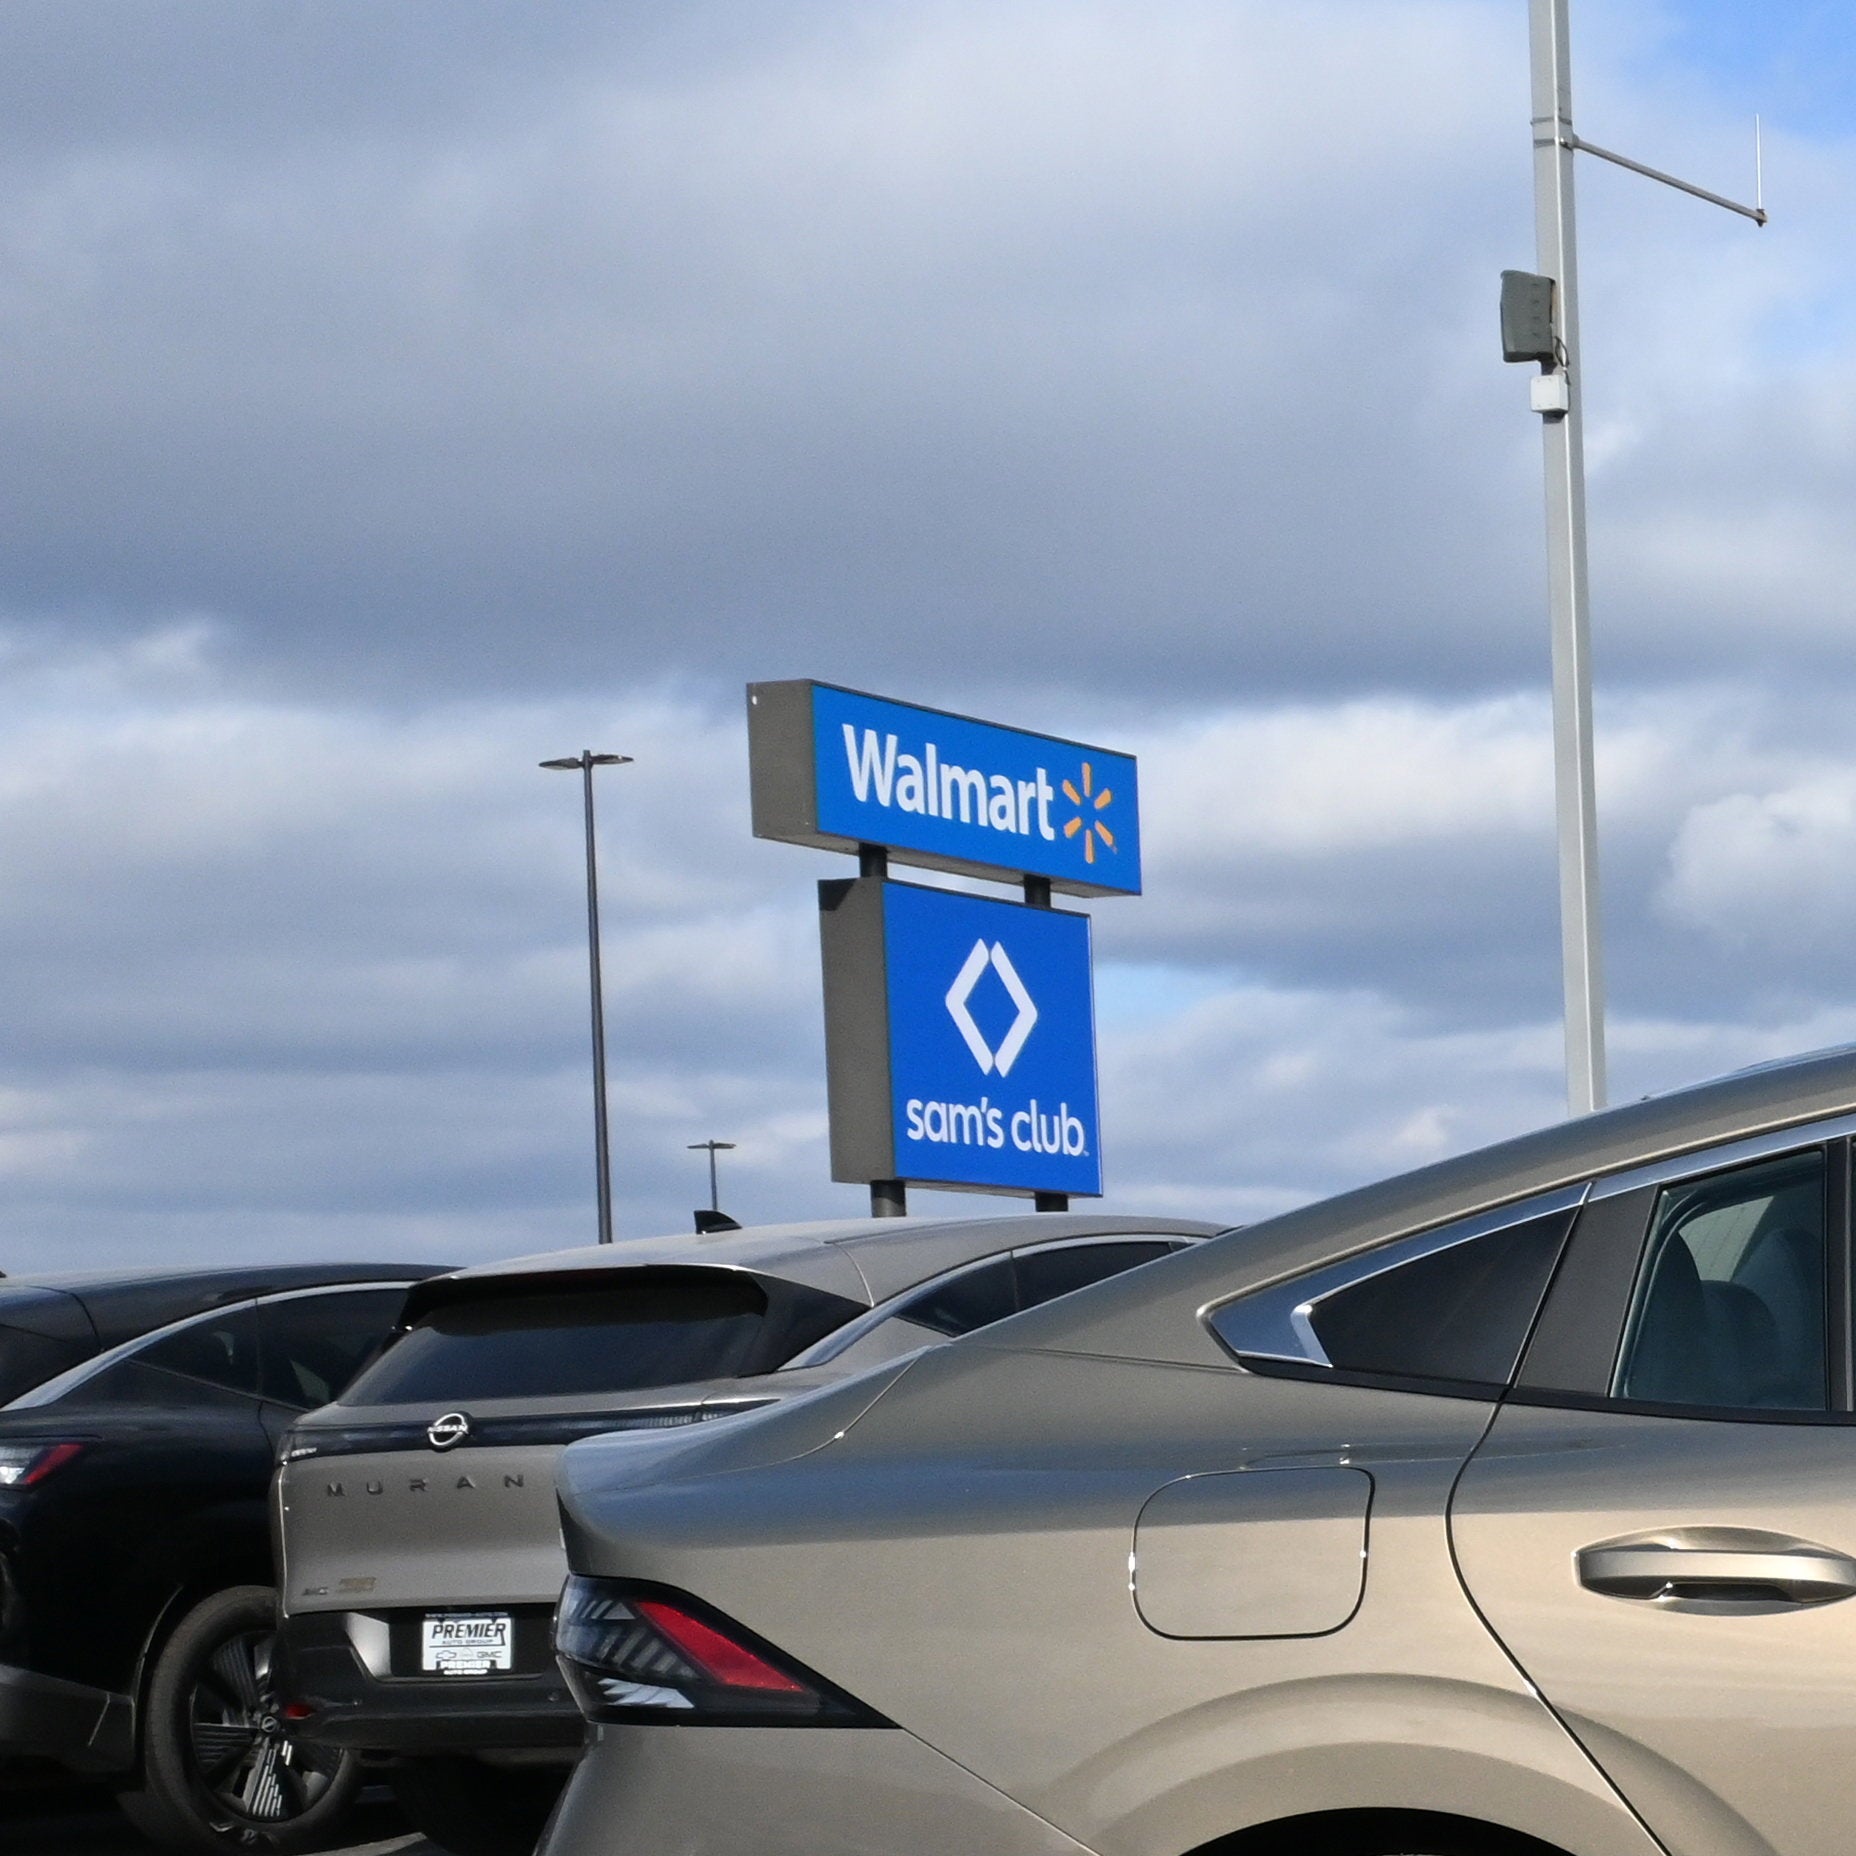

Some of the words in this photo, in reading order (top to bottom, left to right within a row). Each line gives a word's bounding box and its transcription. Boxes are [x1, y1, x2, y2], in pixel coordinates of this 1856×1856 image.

[842, 724, 1056, 841] Walmart
[906, 1096, 1002, 1149] sam's
[1011, 1098, 1086, 1158] club
[431, 1623, 507, 1640] PREMIER
